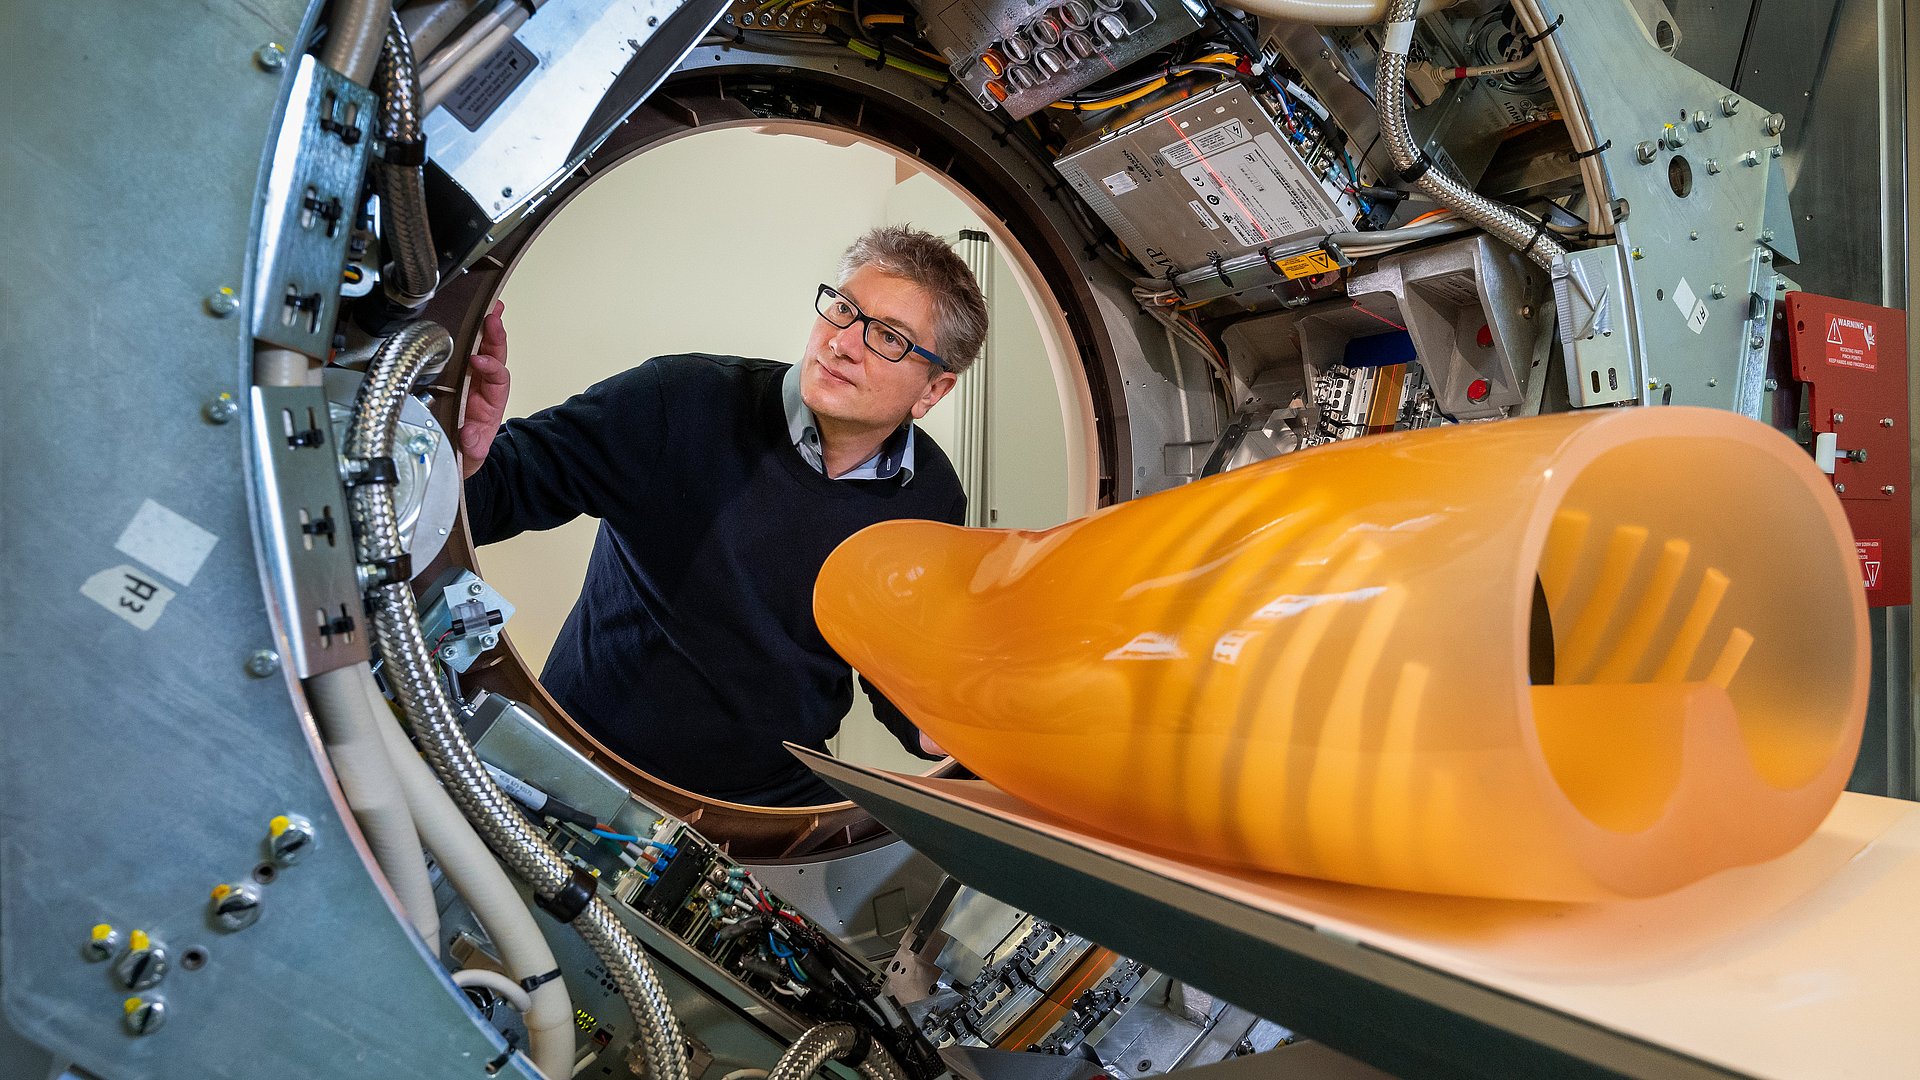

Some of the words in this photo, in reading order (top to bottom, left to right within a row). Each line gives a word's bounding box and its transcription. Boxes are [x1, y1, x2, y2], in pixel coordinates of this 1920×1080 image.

[1504, 101, 1522, 122] HVU1
[1121, 149, 1151, 182] EMERSON
[1696, 306, 1706, 325] A1
[1838, 318, 1864, 329] WARNING
[120, 574, 158, 613] A3
